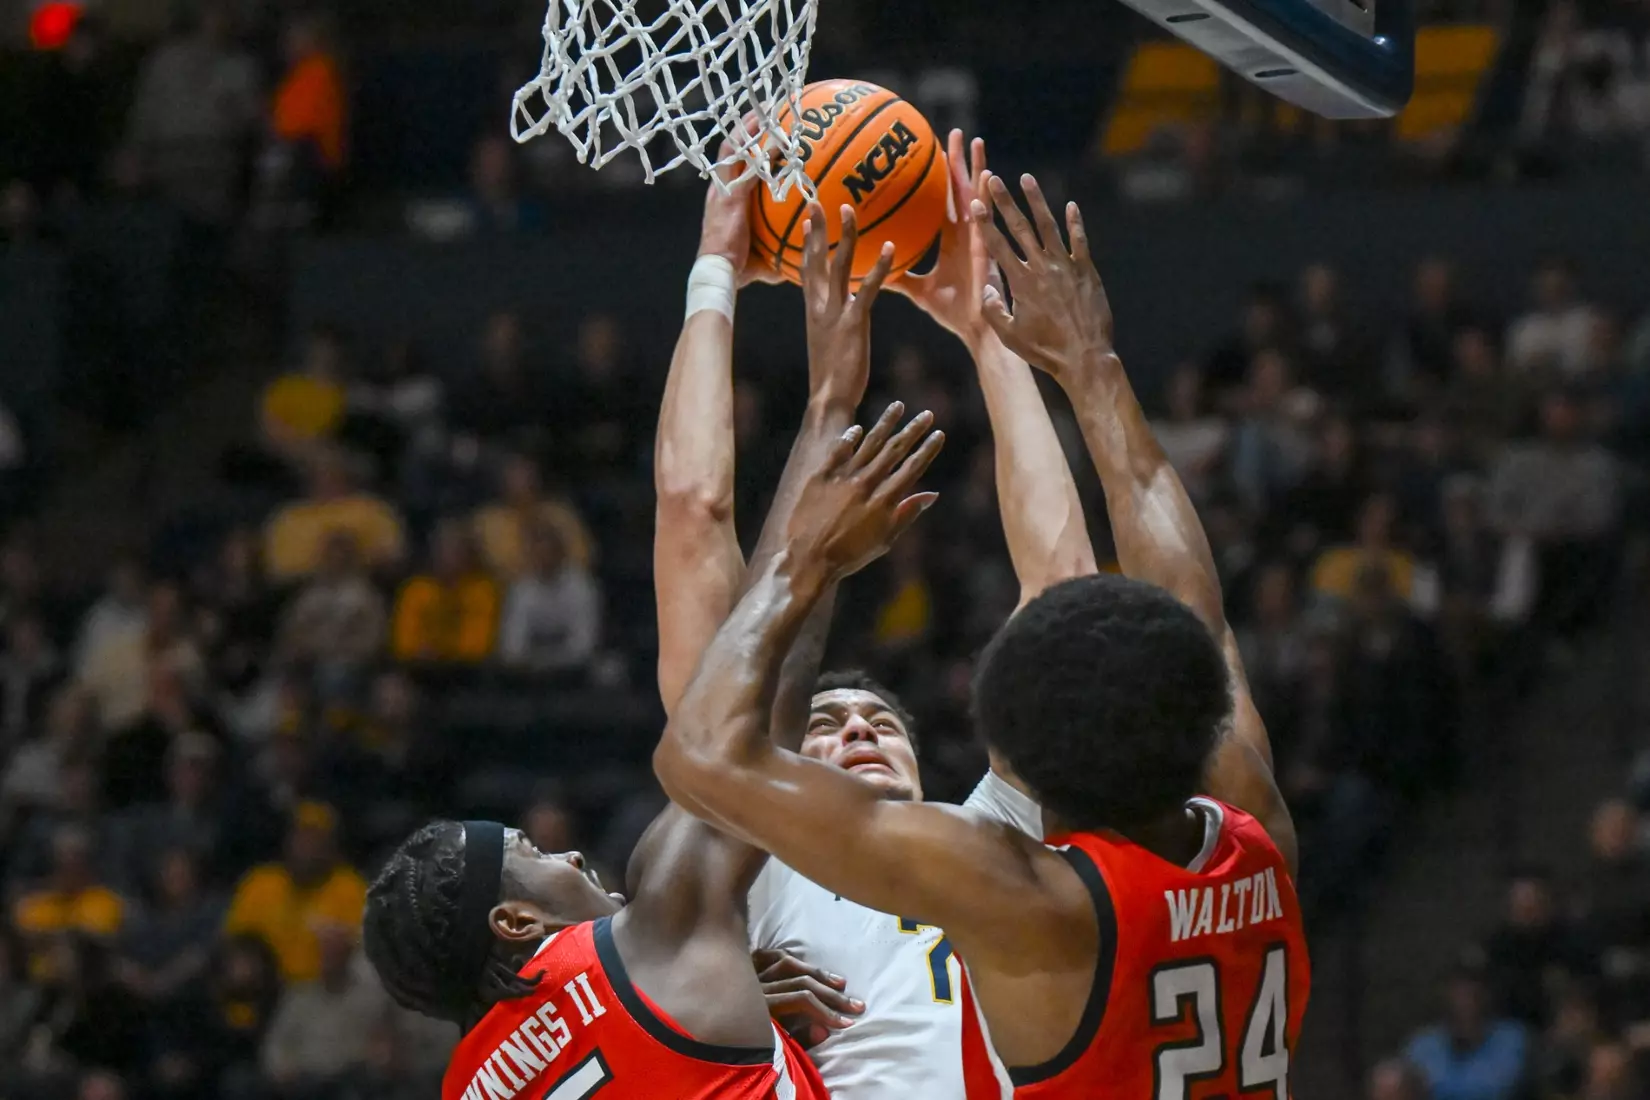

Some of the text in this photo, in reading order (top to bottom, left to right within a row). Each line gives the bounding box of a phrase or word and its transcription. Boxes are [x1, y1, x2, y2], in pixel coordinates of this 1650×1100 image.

[842, 120, 919, 205] NCAA
[1164, 866, 1284, 943] WALTON
[564, 971, 607, 1026] II
[1152, 945, 1290, 1100] 24
